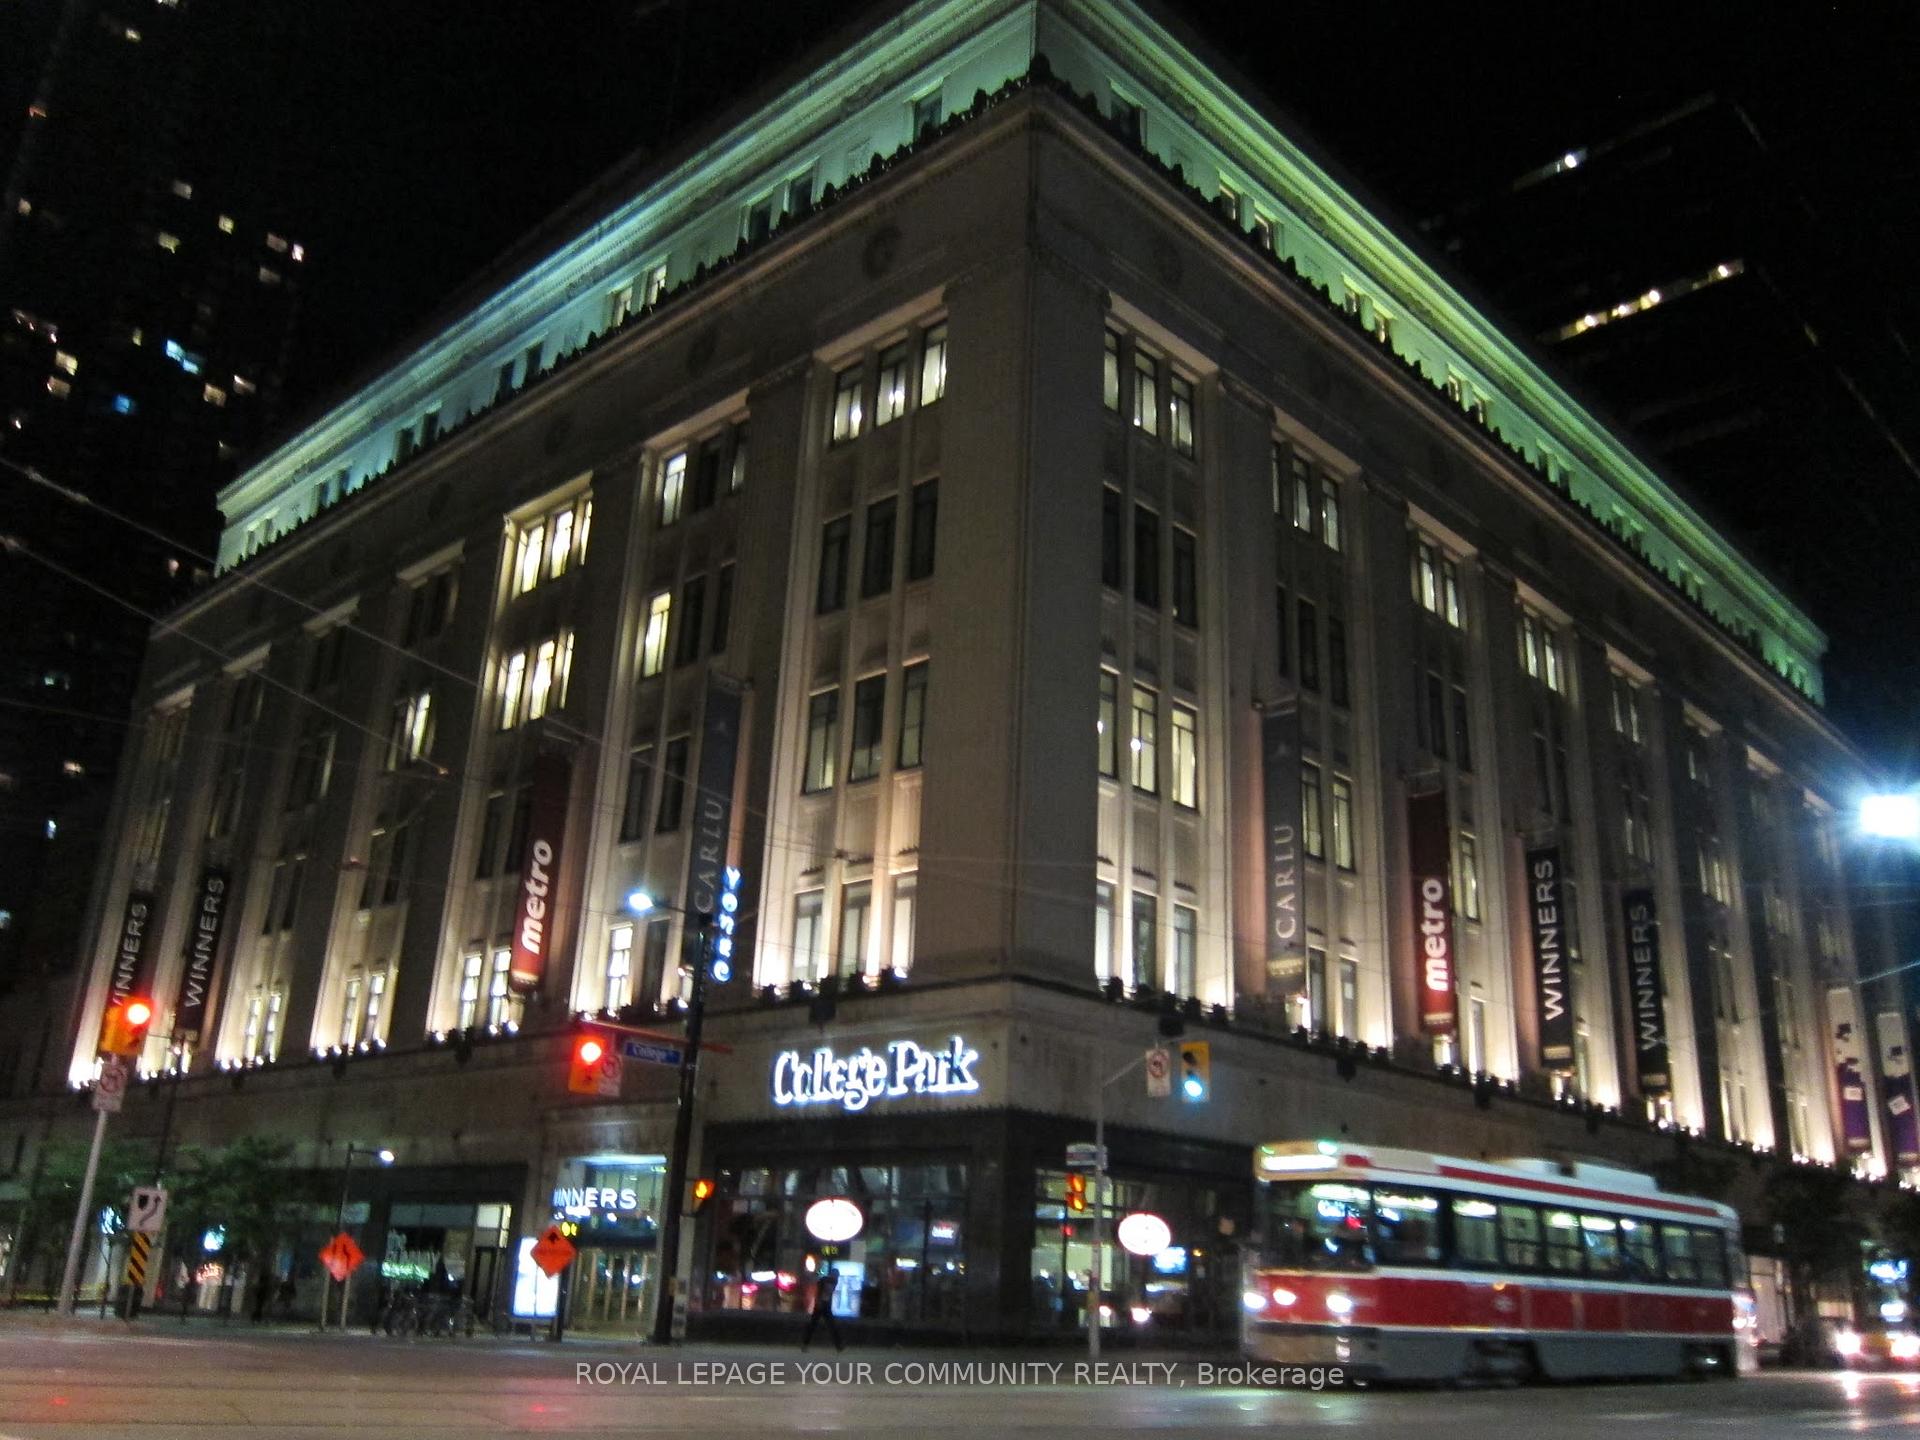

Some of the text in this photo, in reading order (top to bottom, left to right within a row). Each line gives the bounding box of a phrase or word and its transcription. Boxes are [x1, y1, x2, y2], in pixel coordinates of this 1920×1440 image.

[521, 838, 553, 955] metro
[694, 797, 724, 914] CARLU
[1273, 823, 1298, 940] CARLU
[111, 902, 148, 1006] INNERS
[184, 877, 225, 1008] WINNERS
[1422, 878, 1449, 992] metro
[1532, 859, 1566, 1021] WINNERS
[1628, 902, 1662, 1051] WINNERS
[774, 1035, 980, 1111] College Park
